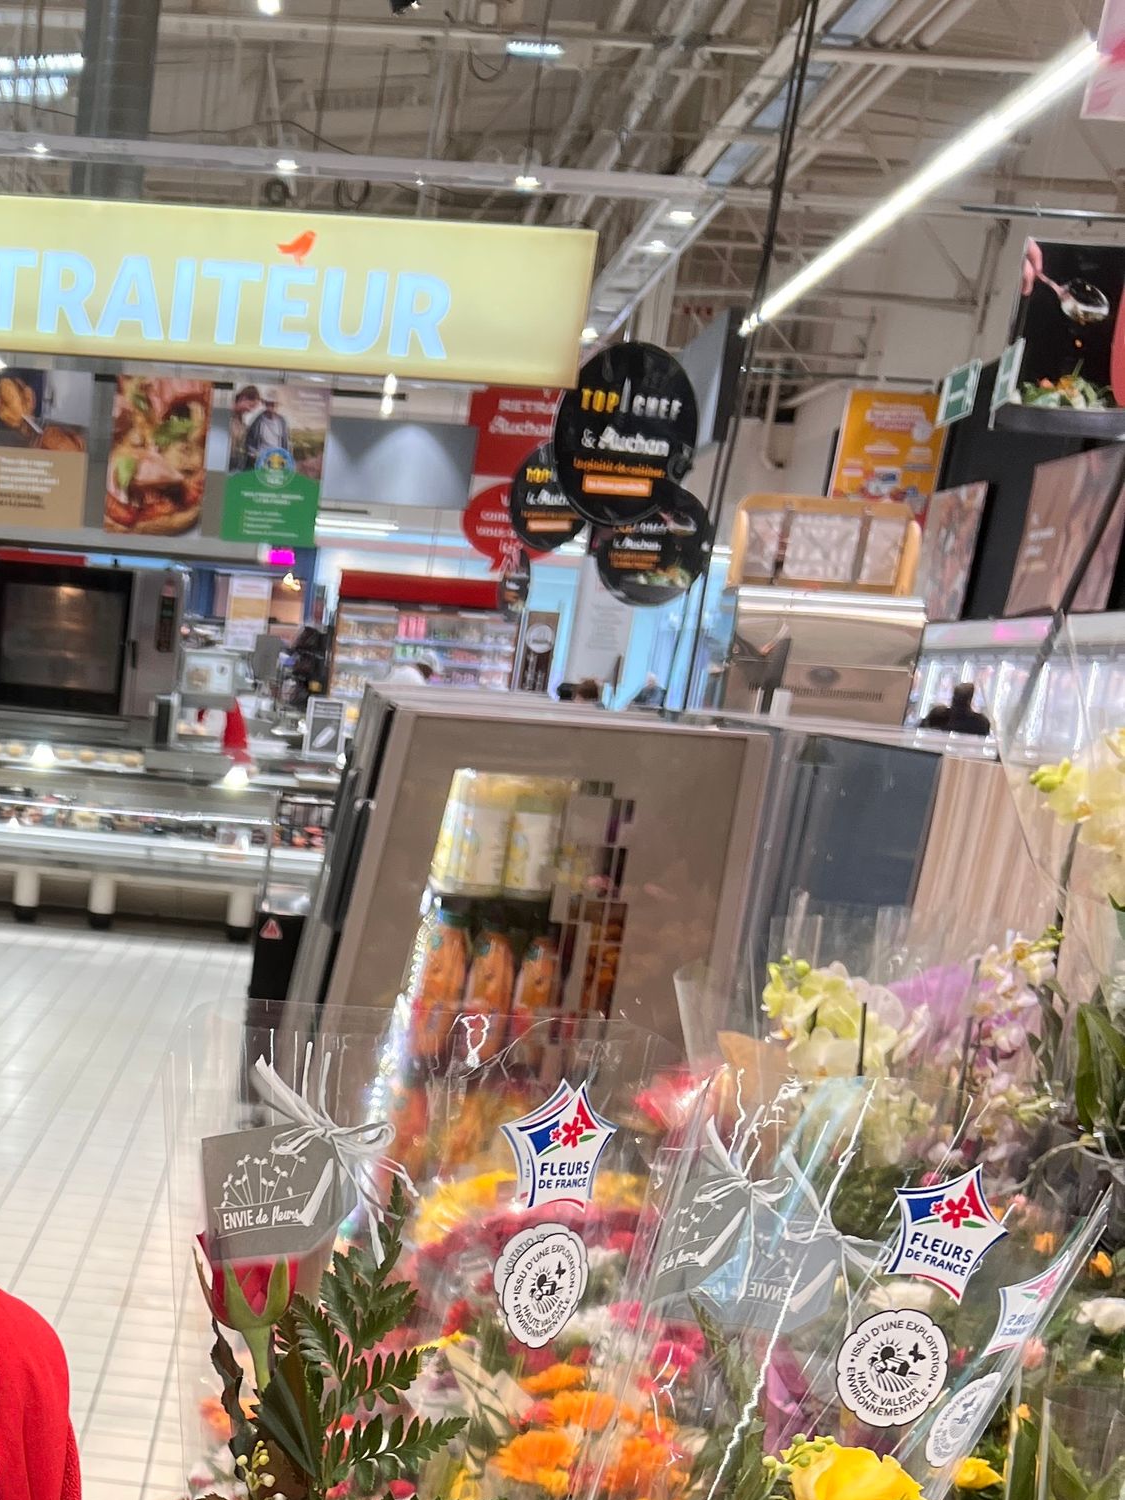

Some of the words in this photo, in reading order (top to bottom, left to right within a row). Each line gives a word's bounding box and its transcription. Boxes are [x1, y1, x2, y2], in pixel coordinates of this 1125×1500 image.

[581, 387, 620, 414] TOP
[581, 428, 597, 450] &
[597, 424, 671, 458] Auchan
[538, 1179, 553, 1189] DE
[555, 1177, 588, 1189] FRANCE
[540, 1161, 590, 1176] FLEURS
[222, 1209, 255, 1230] ENVIE
[256, 1207, 269, 1225] de
[905, 1248, 920, 1262] DE
[923, 1254, 968, 1278] FRANCE
[910, 1232, 974, 1264] FLEURS
[512, 1269, 528, 1296] ISSU
[526, 1245, 551, 1271] D'UNE
[551, 1244, 577, 1290] EXPLOITATION
[512, 1298, 571, 1338] ENVIRONNEMENTALE
[523, 1304, 541, 1329] HAUTE
[540, 1300, 565, 1329] VALEUR
[851, 1334, 871, 1358] ISSU
[872, 1320, 905, 1337] D'UNE
[906, 1320, 940, 1382] EXPLOITATION
[846, 1366, 929, 1417] ENVIRONNEMENTALE
[856, 1371, 878, 1403] HAUTE
[880, 1387, 920, 1407] VALEUR
